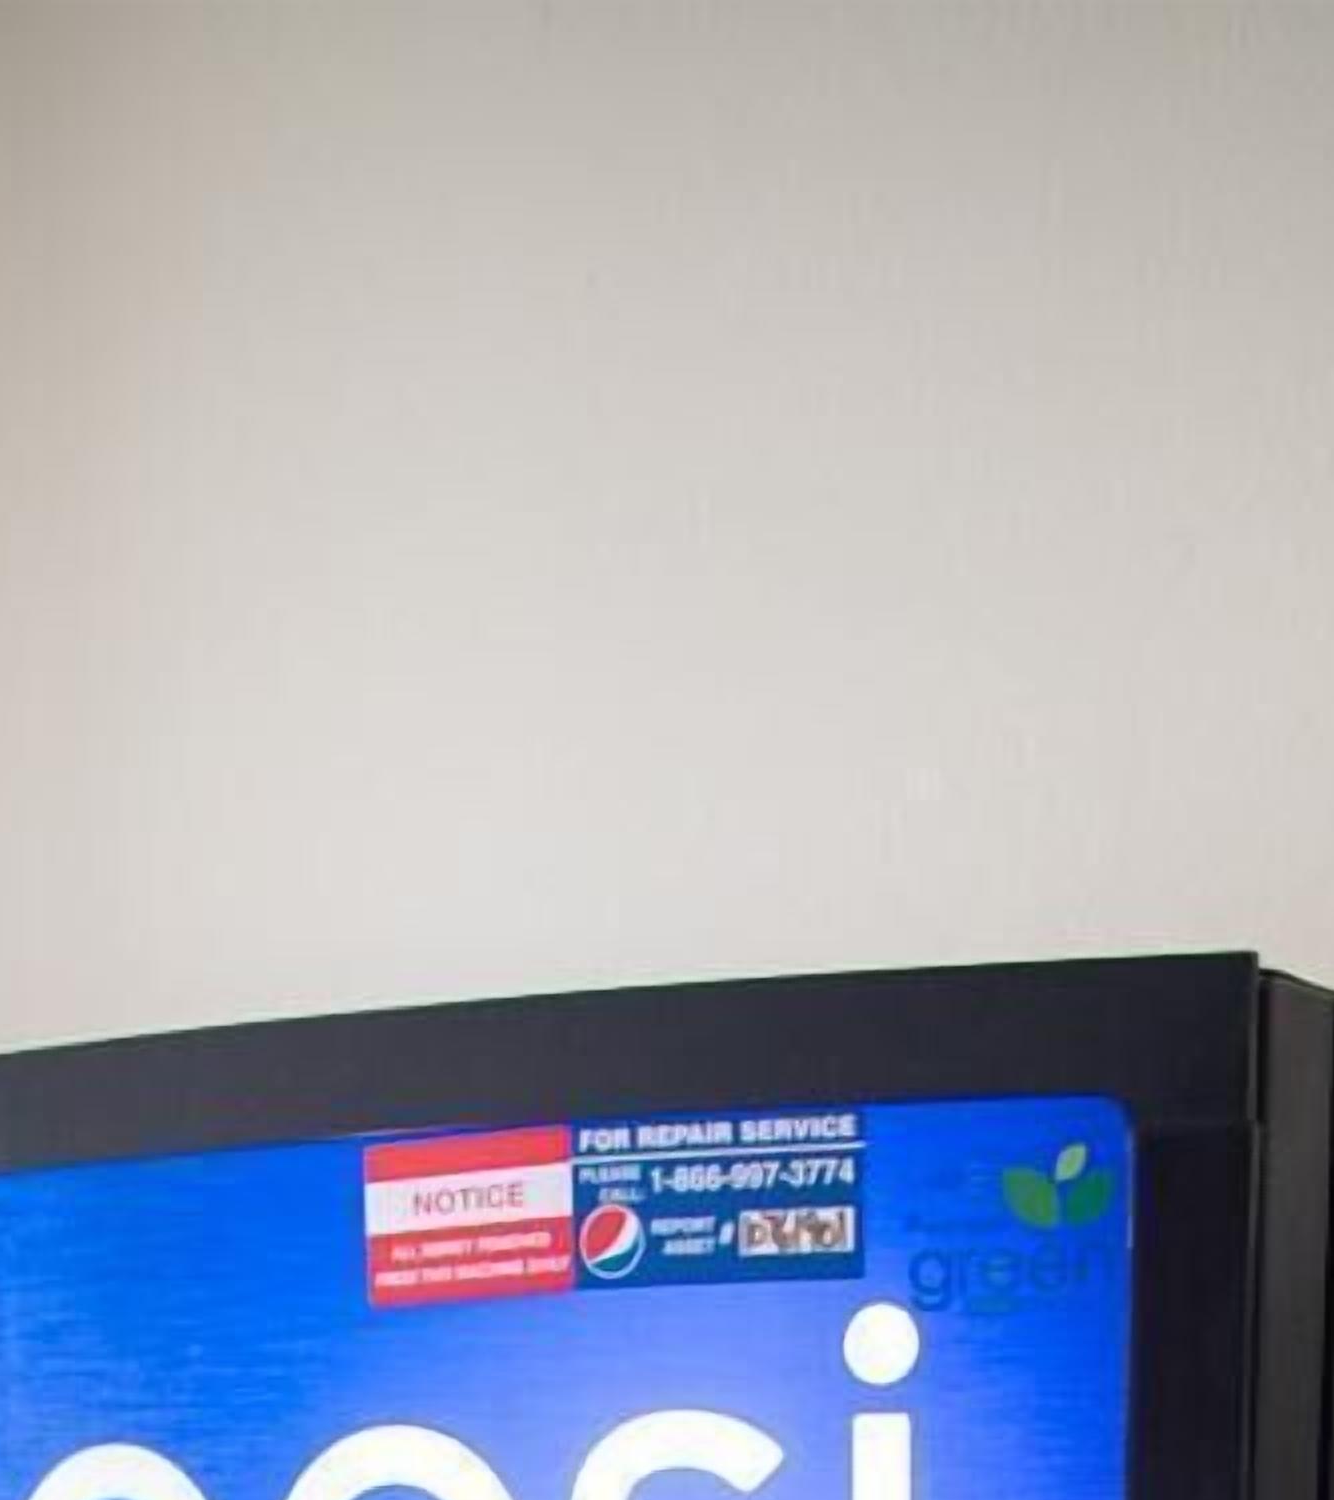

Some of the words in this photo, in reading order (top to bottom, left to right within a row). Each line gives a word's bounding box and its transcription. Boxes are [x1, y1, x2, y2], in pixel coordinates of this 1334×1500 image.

[578, 1128, 630, 1152] FOR
[636, 1121, 734, 1148] REPAIR
[739, 1114, 857, 1143] SERVICE
[413, 1181, 524, 1216] NOTICE
